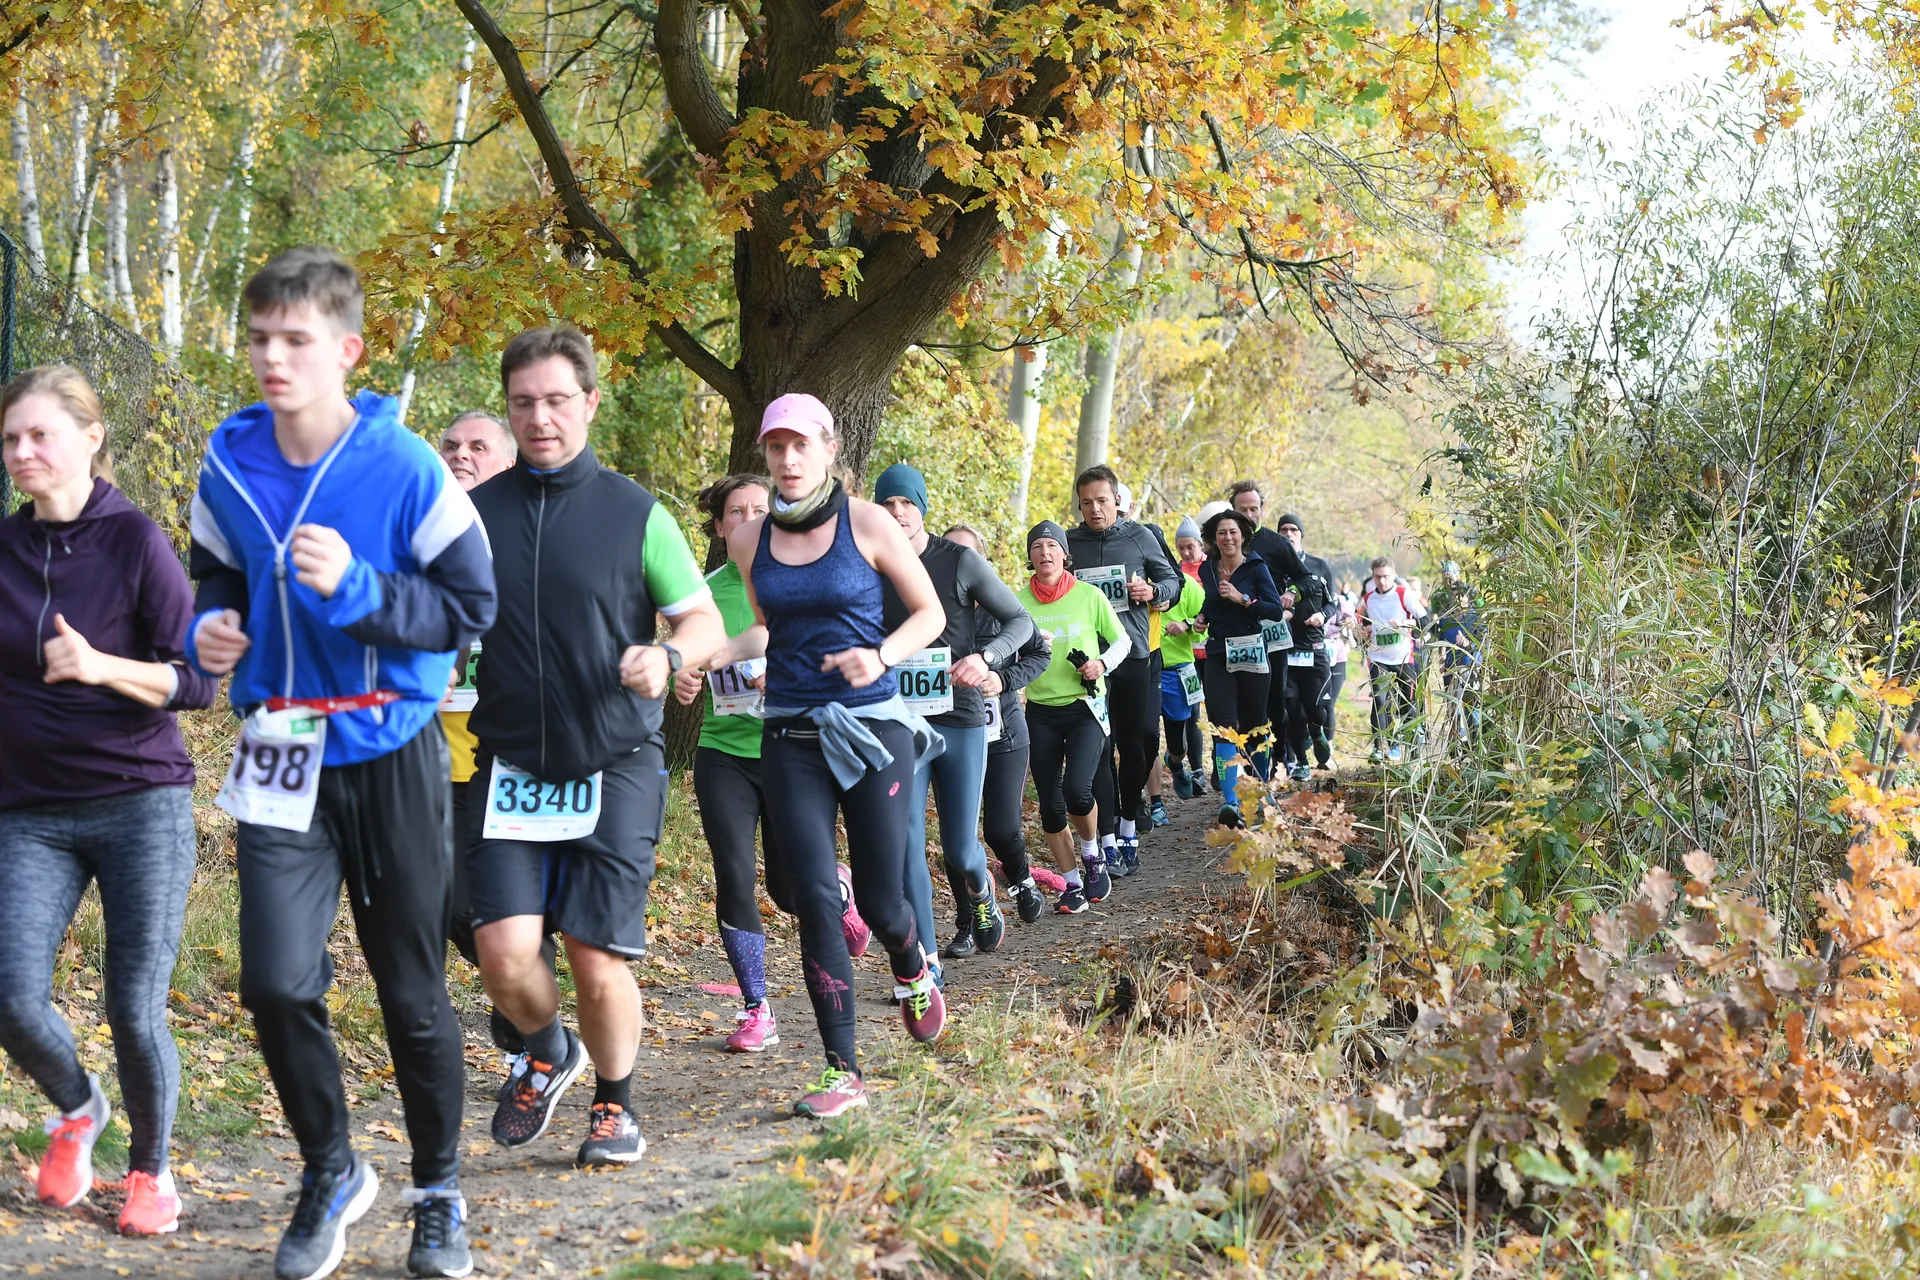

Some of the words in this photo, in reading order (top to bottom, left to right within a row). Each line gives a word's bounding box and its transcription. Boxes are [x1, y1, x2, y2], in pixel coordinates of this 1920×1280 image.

[1091, 580, 1124, 600] 08
[1376, 633, 1399, 645] 2137
[1229, 647, 1264, 664] 3347
[496, 777, 593, 813] 3340
